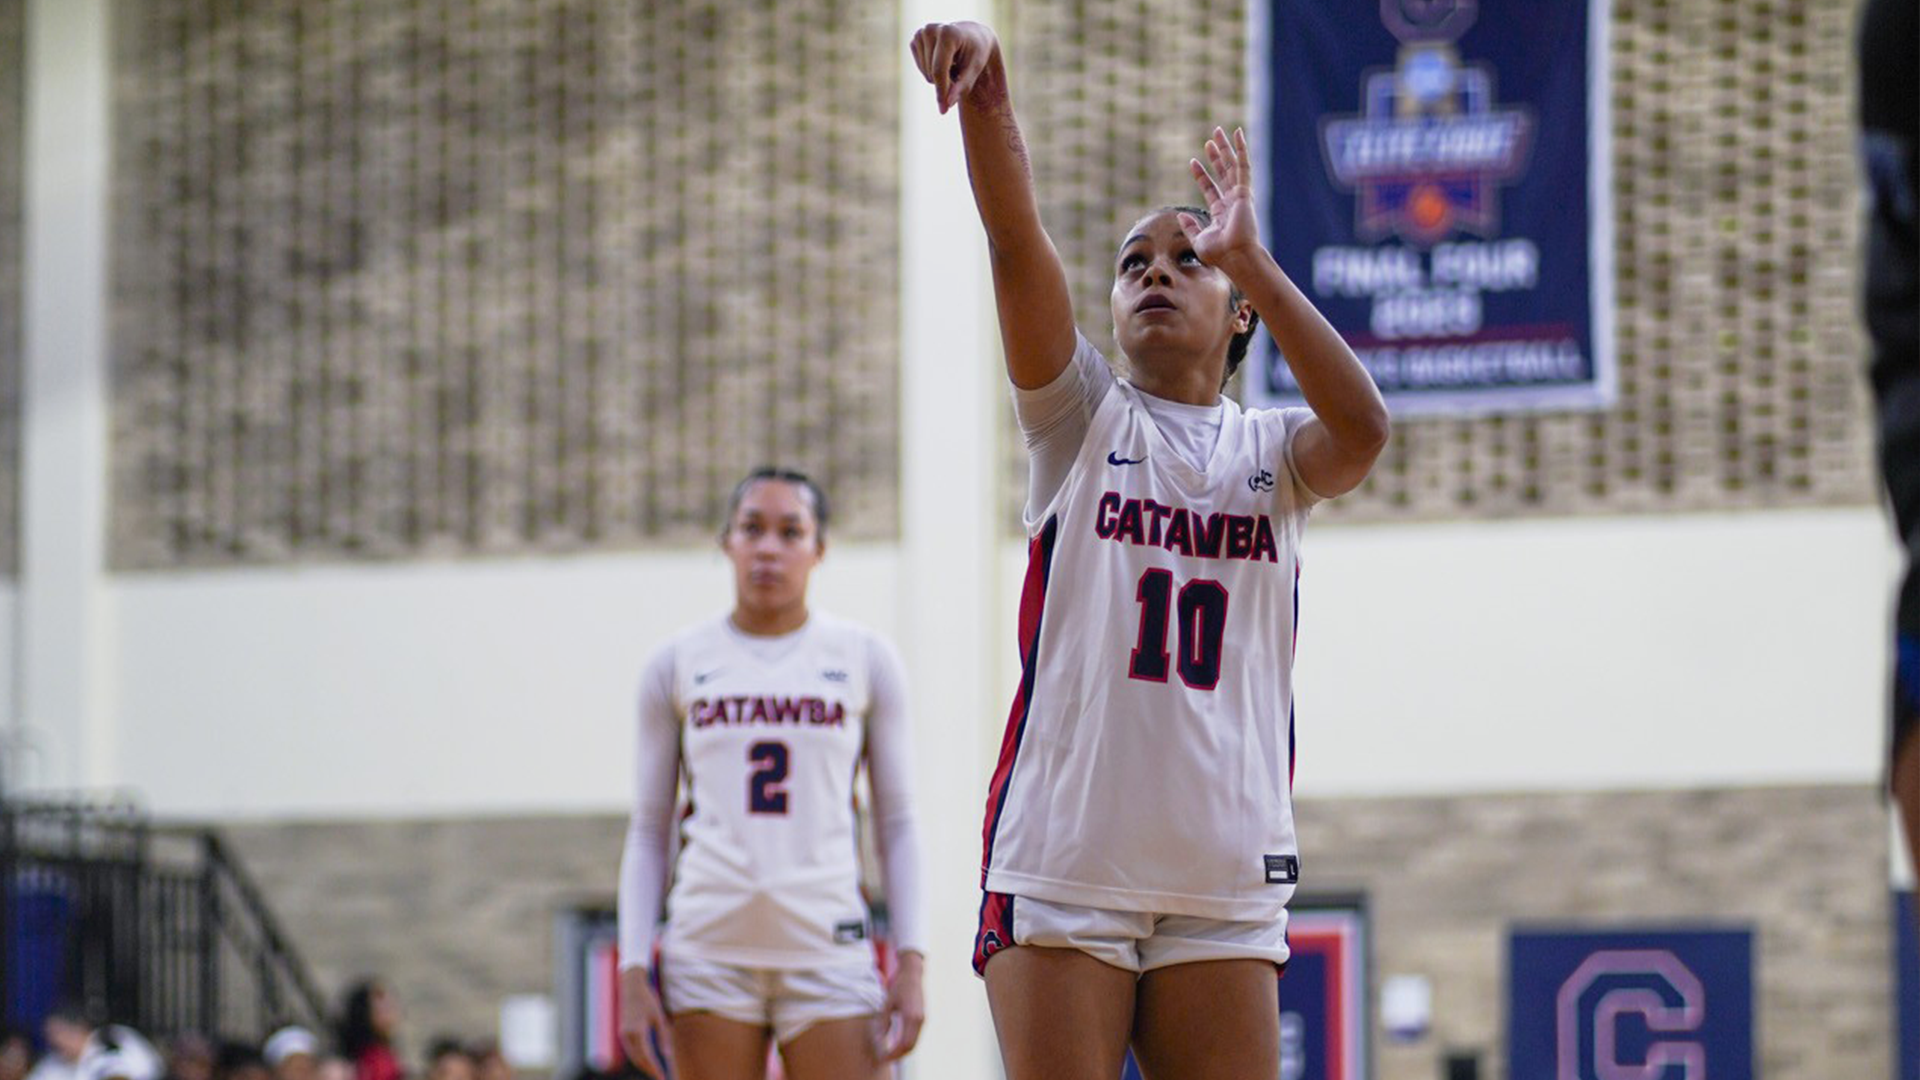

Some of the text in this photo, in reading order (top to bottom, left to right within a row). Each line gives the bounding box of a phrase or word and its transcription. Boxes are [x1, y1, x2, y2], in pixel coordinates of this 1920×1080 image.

[1313, 239, 1539, 297] FINAL FOUR
[1402, 341, 1581, 385] BASKETBALL
[1095, 491, 1278, 563] CATAWBA
[1129, 567, 1229, 691] 10
[690, 695, 846, 729] CATAWBA
[748, 738, 791, 817] 2
[1557, 950, 1705, 1080] C
